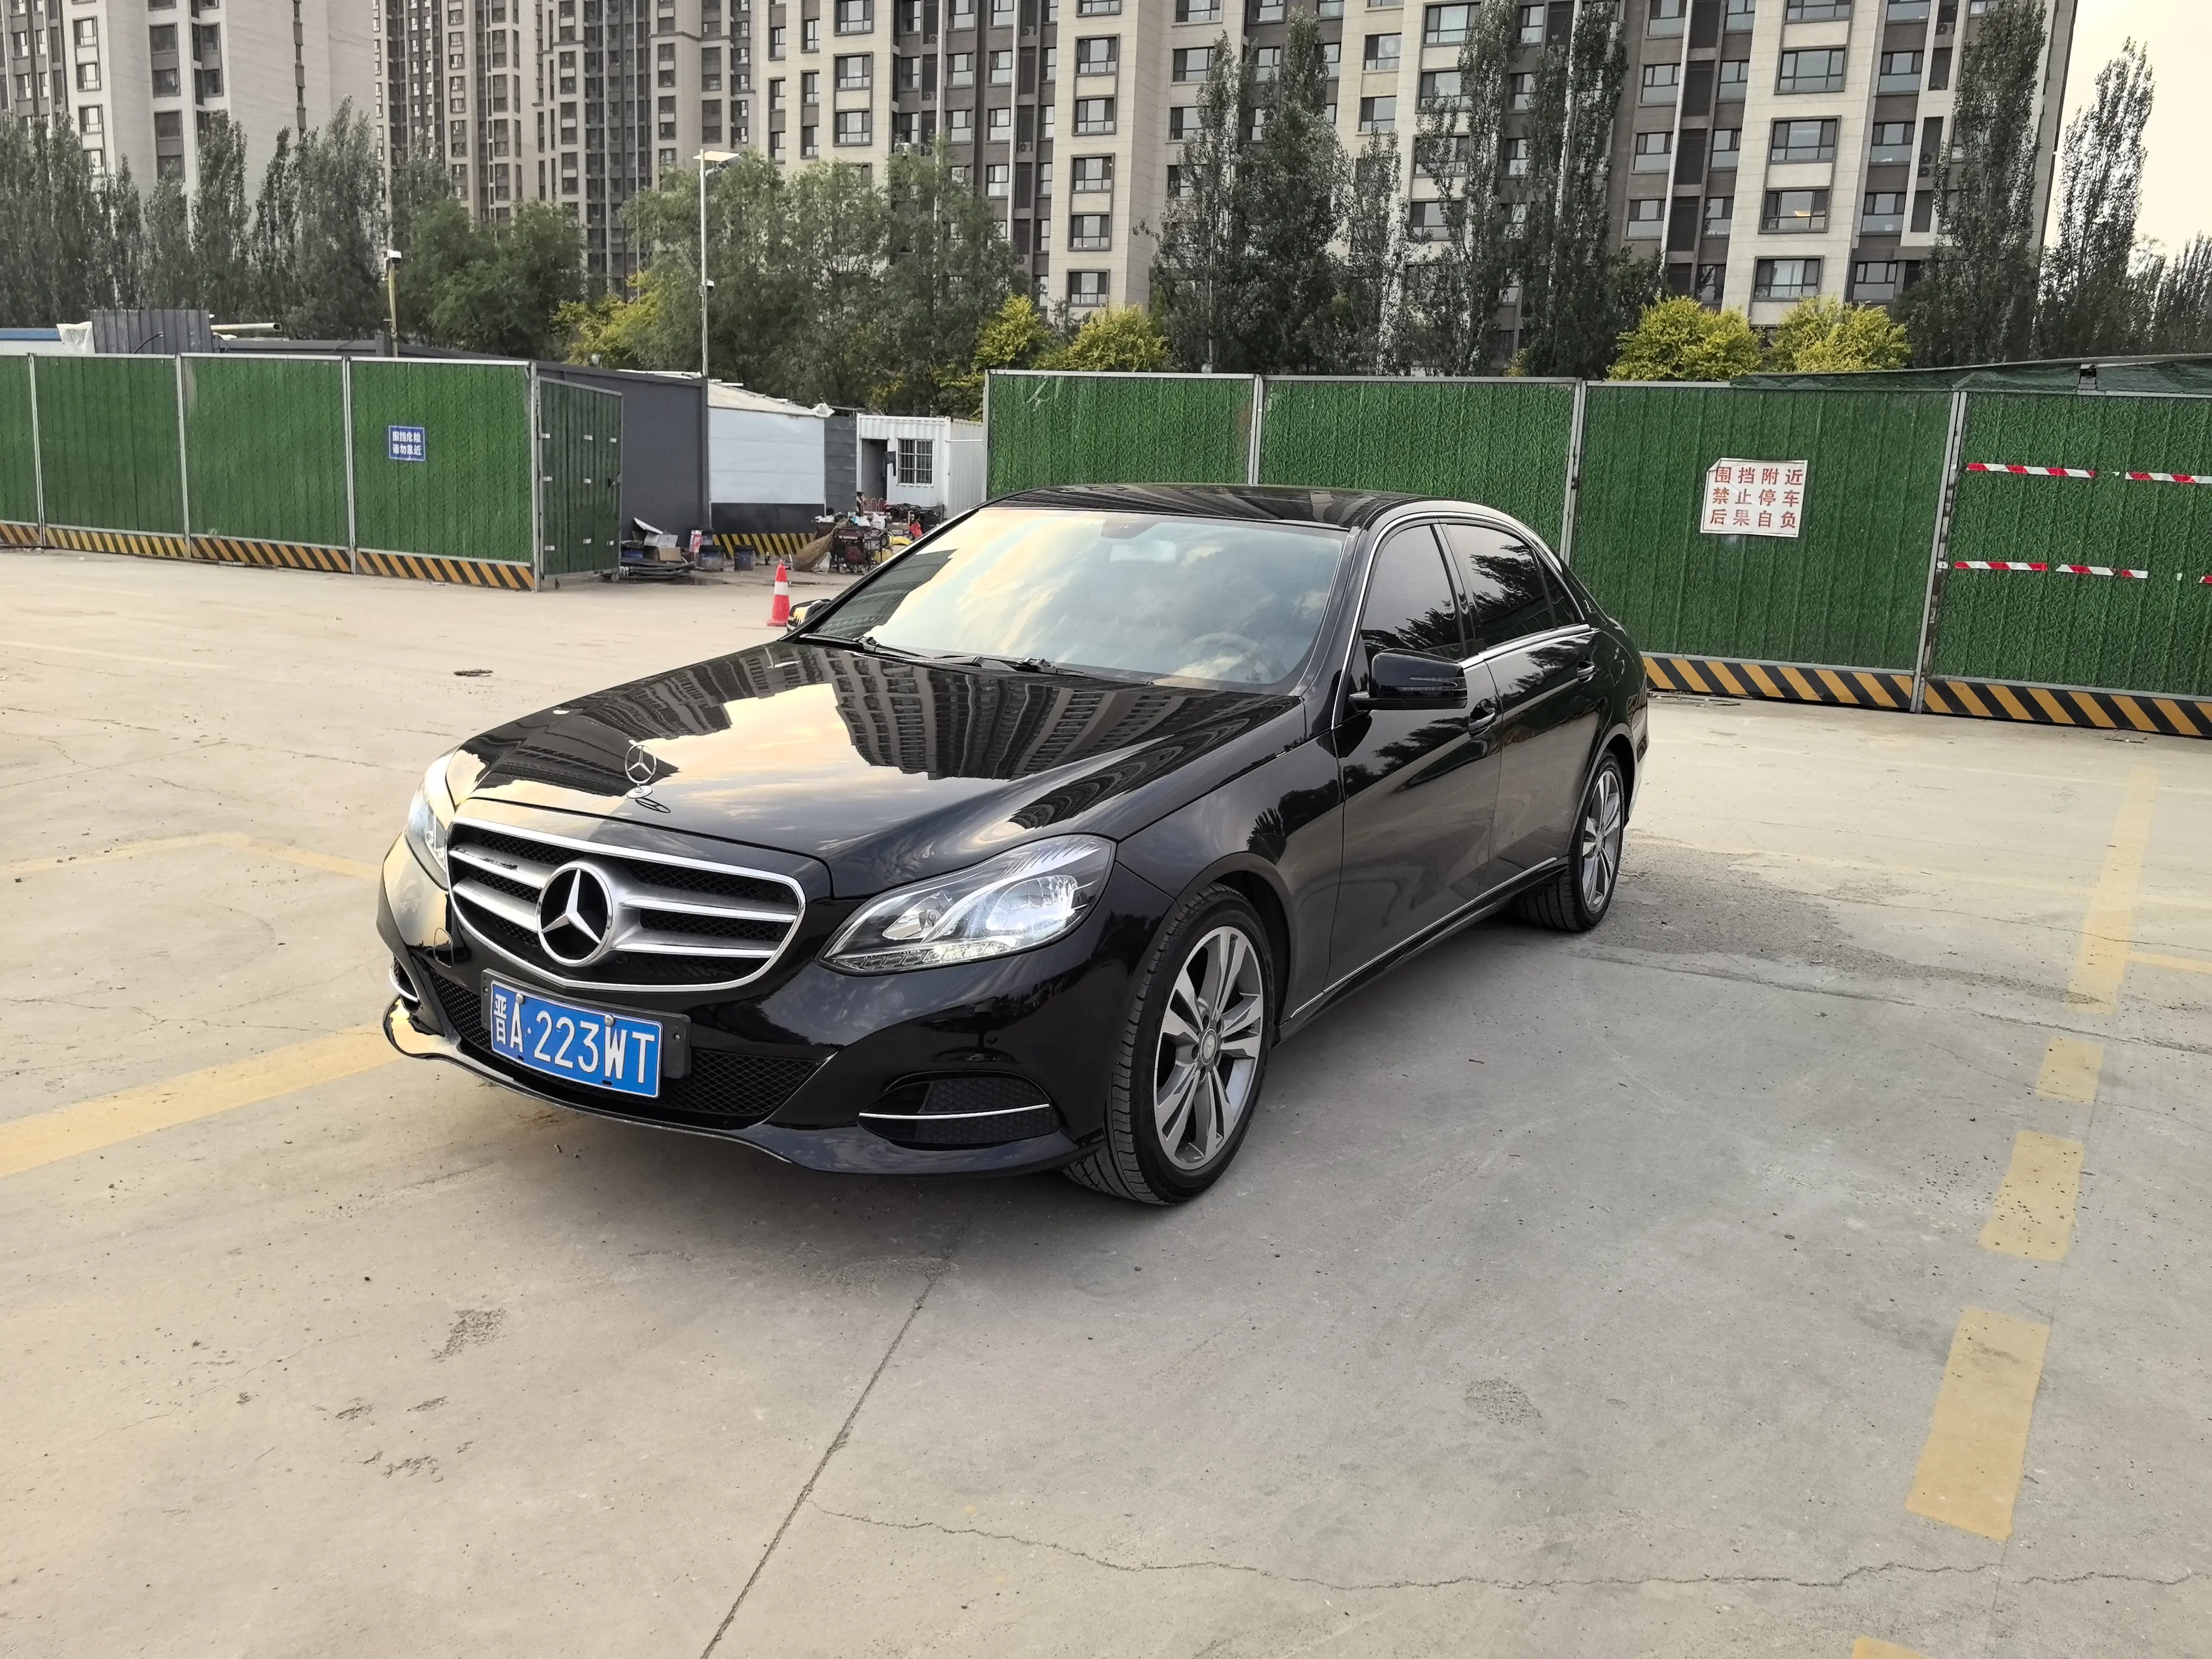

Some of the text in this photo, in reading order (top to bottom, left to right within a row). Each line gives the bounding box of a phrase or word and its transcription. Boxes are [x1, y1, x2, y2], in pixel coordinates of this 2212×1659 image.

[1714, 466, 1803, 486] 围挡附近
[1712, 487, 1801, 508] 禁止停车
[1709, 508, 1797, 529] 后果自负
